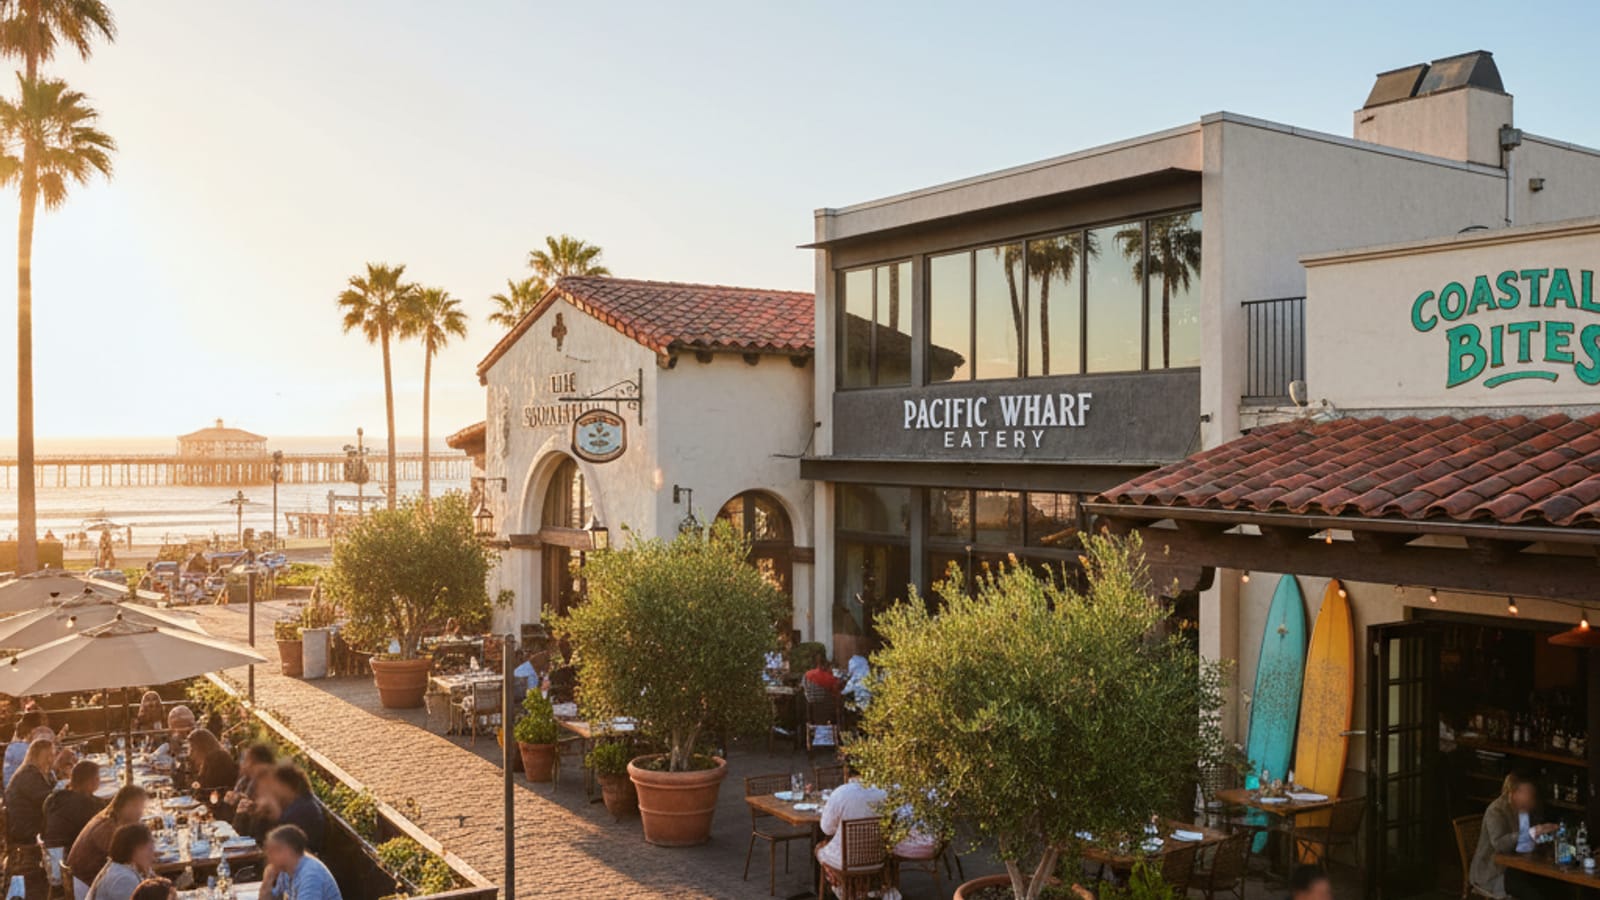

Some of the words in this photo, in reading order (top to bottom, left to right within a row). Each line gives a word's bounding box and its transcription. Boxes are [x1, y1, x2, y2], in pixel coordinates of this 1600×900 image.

[1411, 268, 1600, 332] COASTAL
[1445, 320, 1600, 389] BITES
[903, 396, 988, 429] PACIFIC
[999, 392, 1093, 427] WHARF
[943, 430, 1045, 448] EATERY
